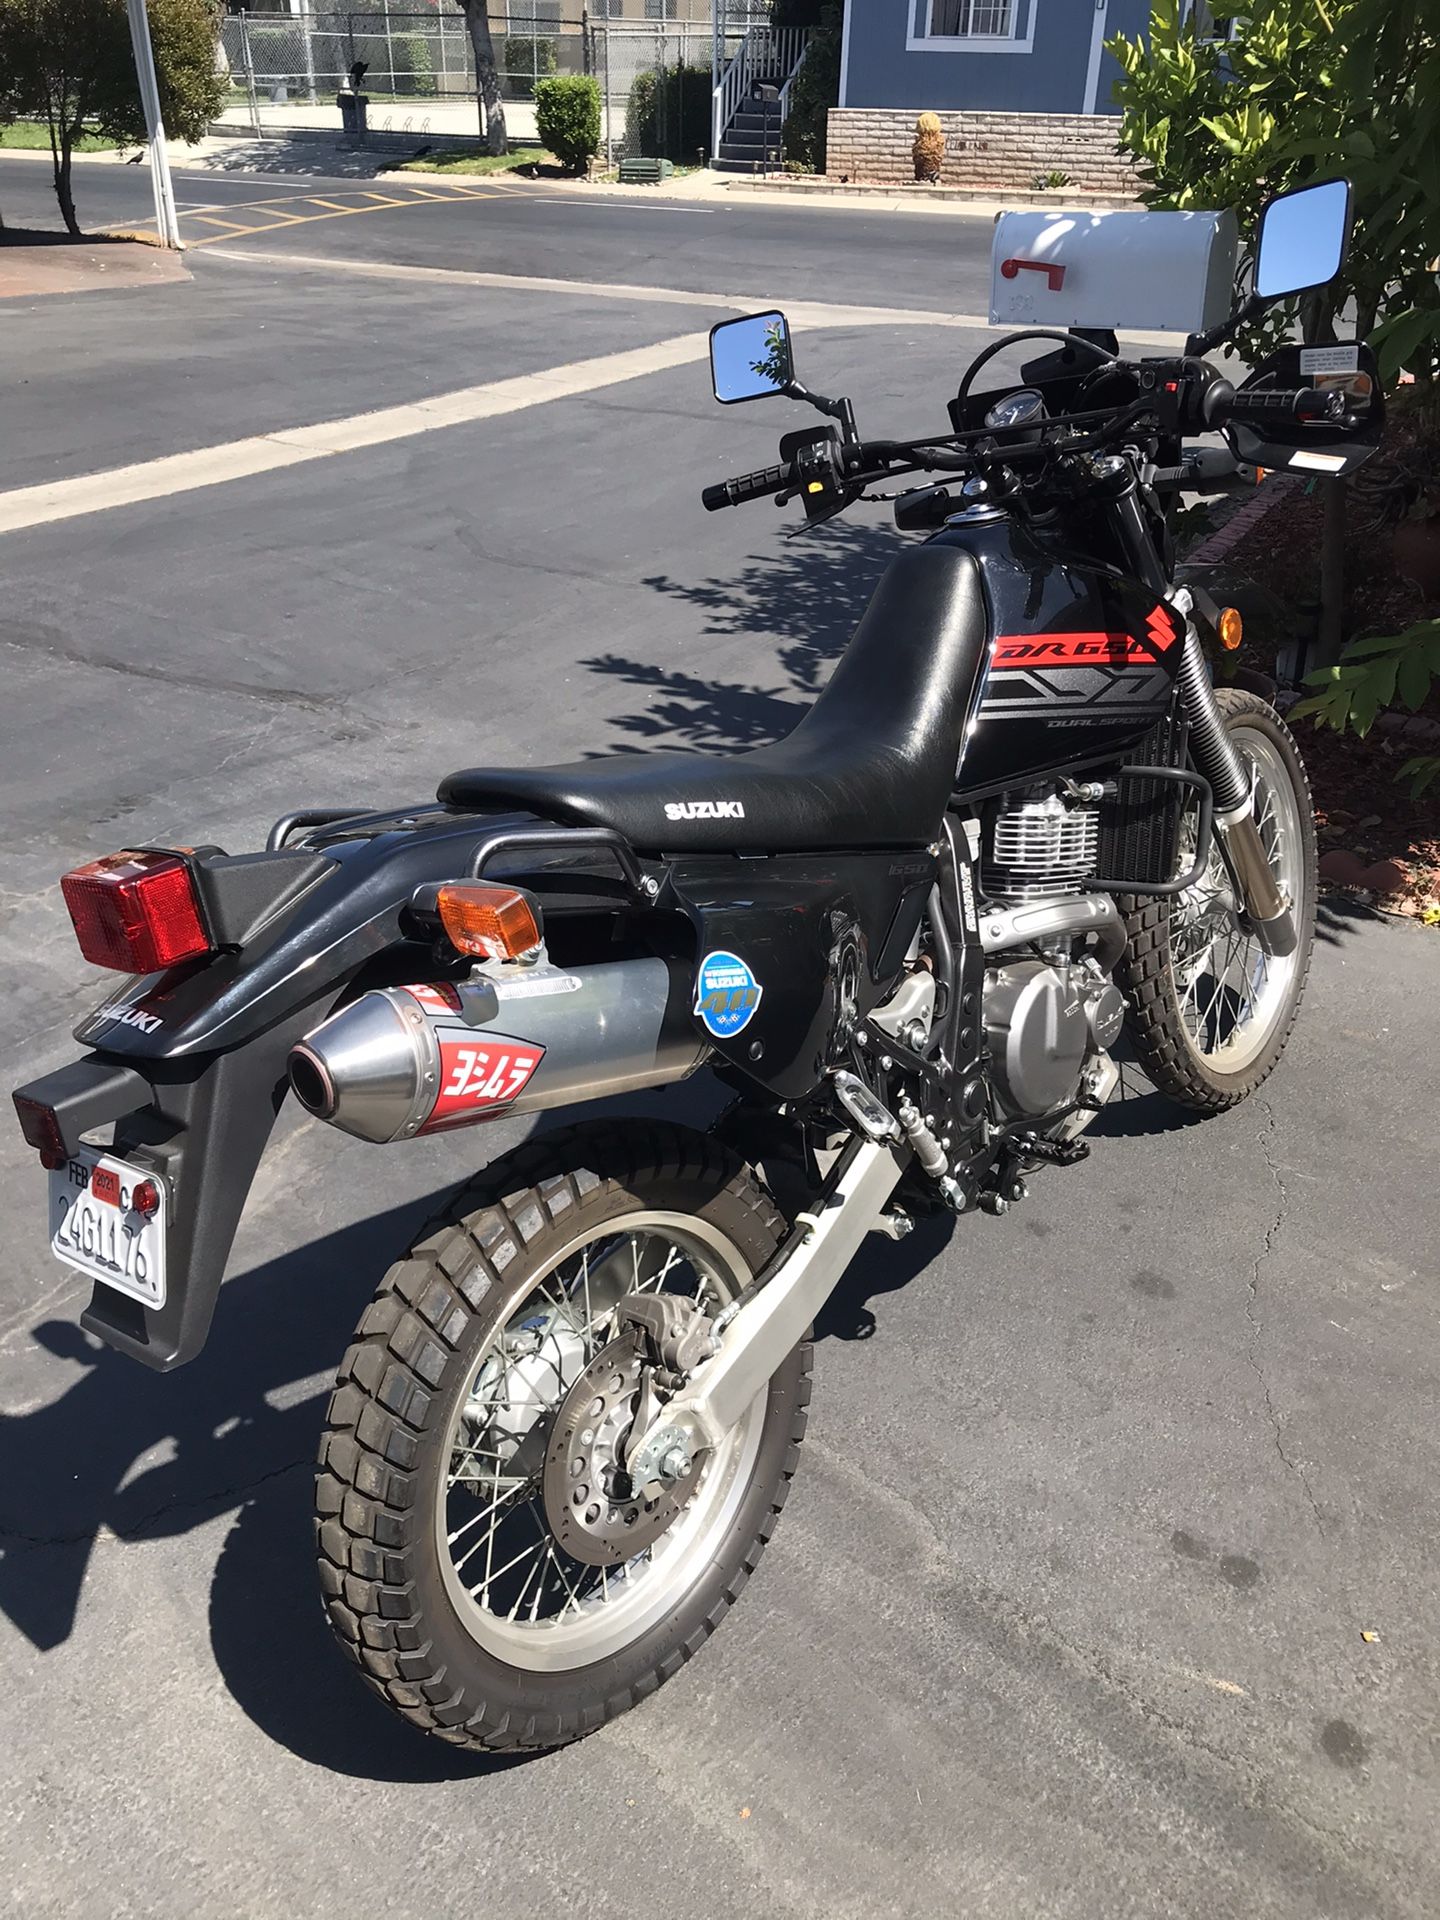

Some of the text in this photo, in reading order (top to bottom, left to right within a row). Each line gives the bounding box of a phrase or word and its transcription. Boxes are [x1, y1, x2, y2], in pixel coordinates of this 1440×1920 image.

[997, 642, 1068, 659] DR
[1047, 719, 1097, 729] DUAL
[664, 801, 745, 821] SUZUKI
[443, 1050, 534, 1099] ヨシムラ
[69, 1161, 89, 1189] FEB
